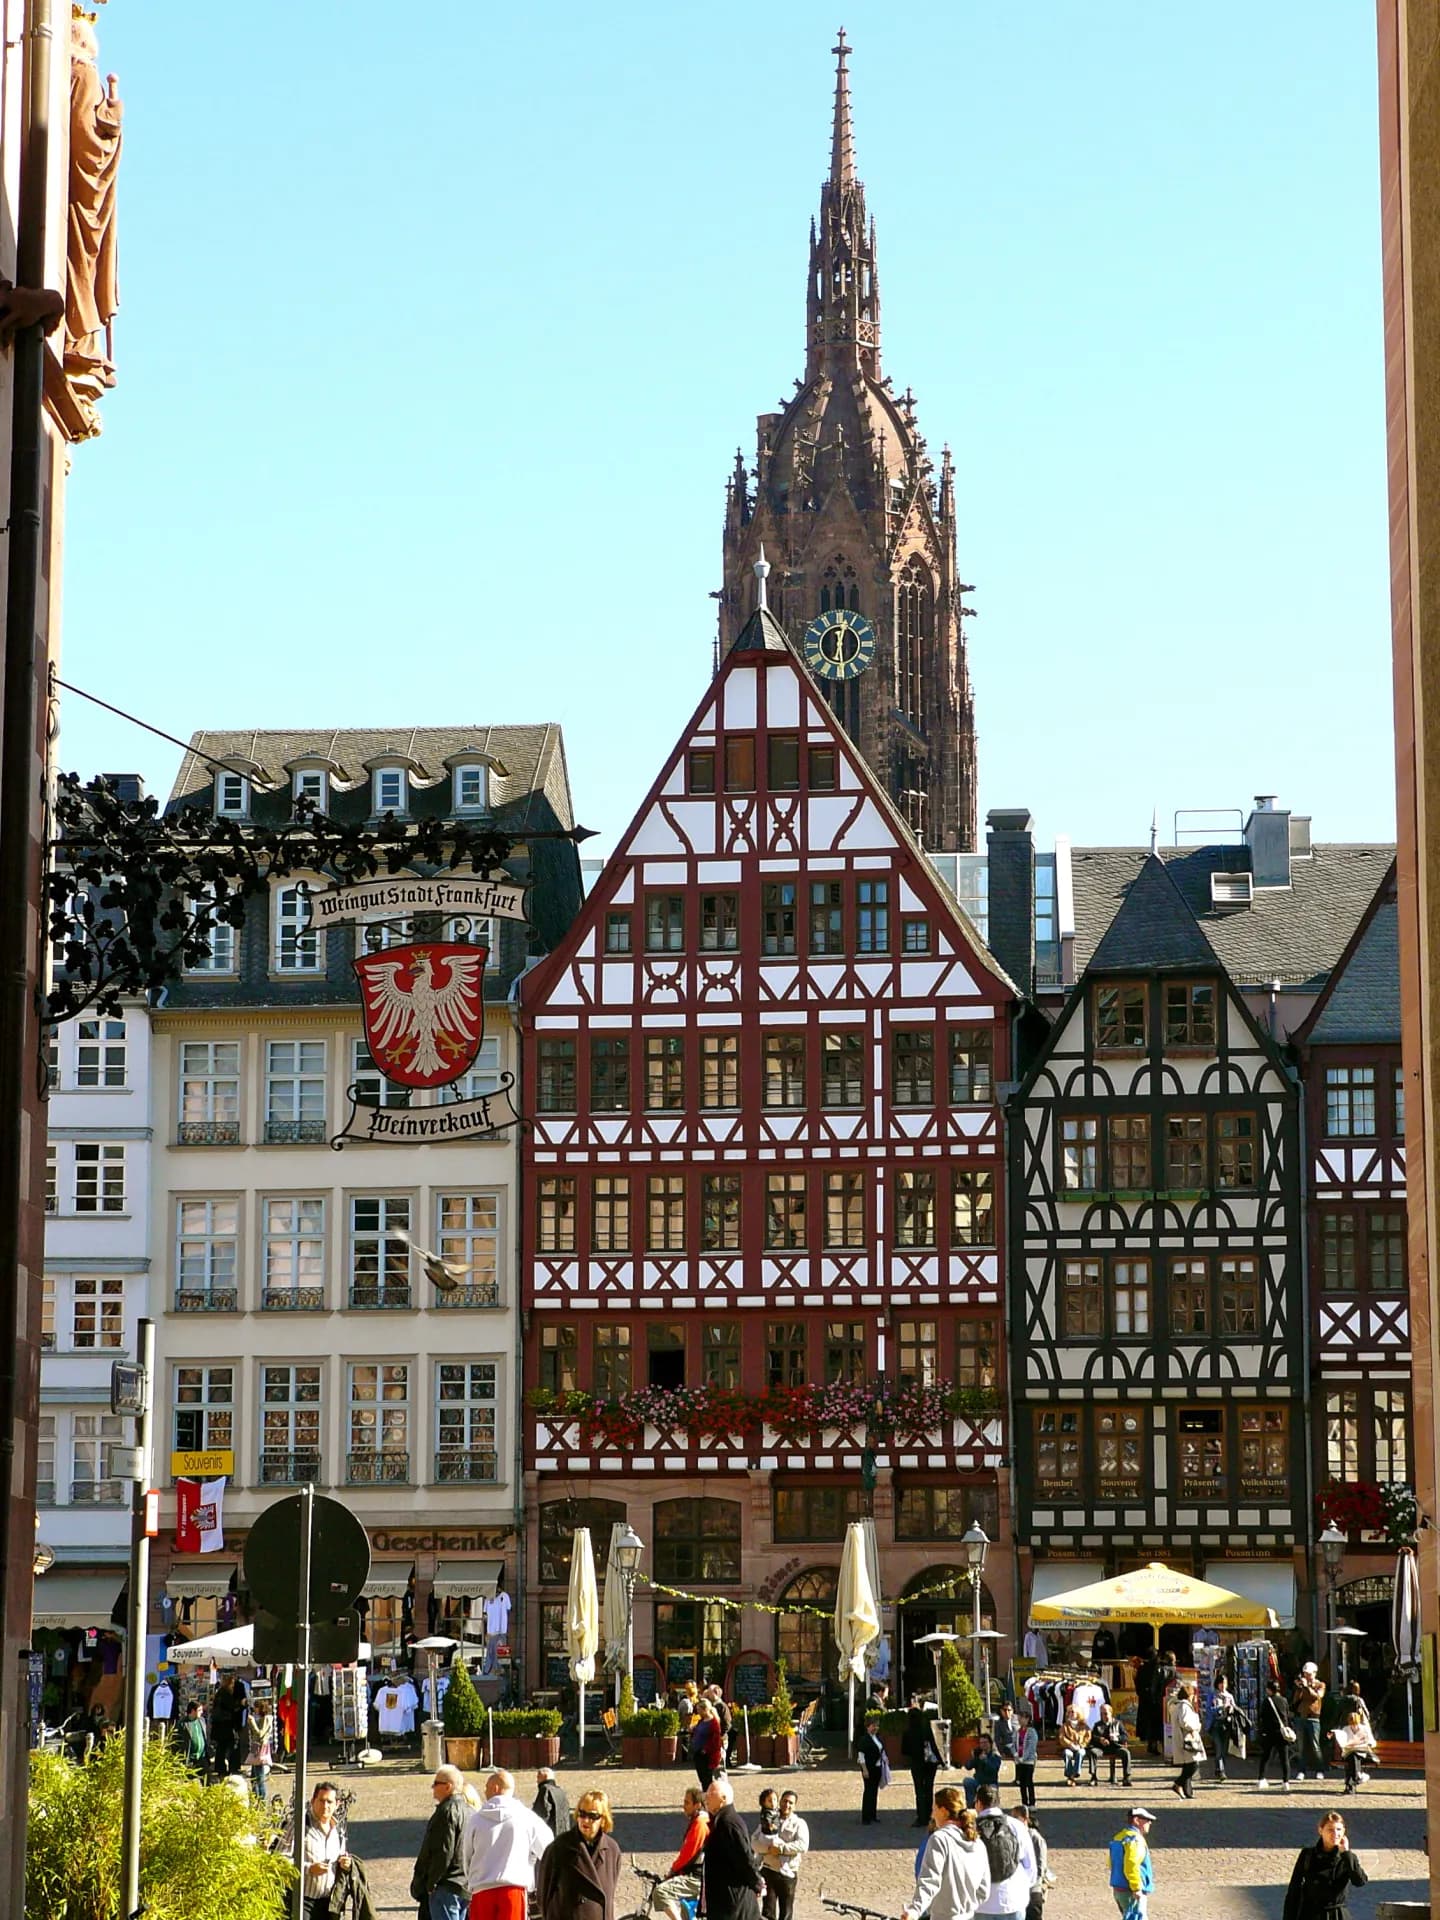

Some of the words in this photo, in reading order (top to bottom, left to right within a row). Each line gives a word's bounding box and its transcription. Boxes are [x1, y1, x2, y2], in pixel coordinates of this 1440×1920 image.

[319, 888, 386, 915] Weingut
[387, 886, 433, 905] Stadt
[435, 884, 518, 912] Frankfurt
[367, 1104, 493, 1136] Weinverkauf
[183, 1454, 223, 1471] Souvenirs
[1241, 1478, 1288, 1487] Volkskunst
[372, 1532, 506, 1551] Geschenke
